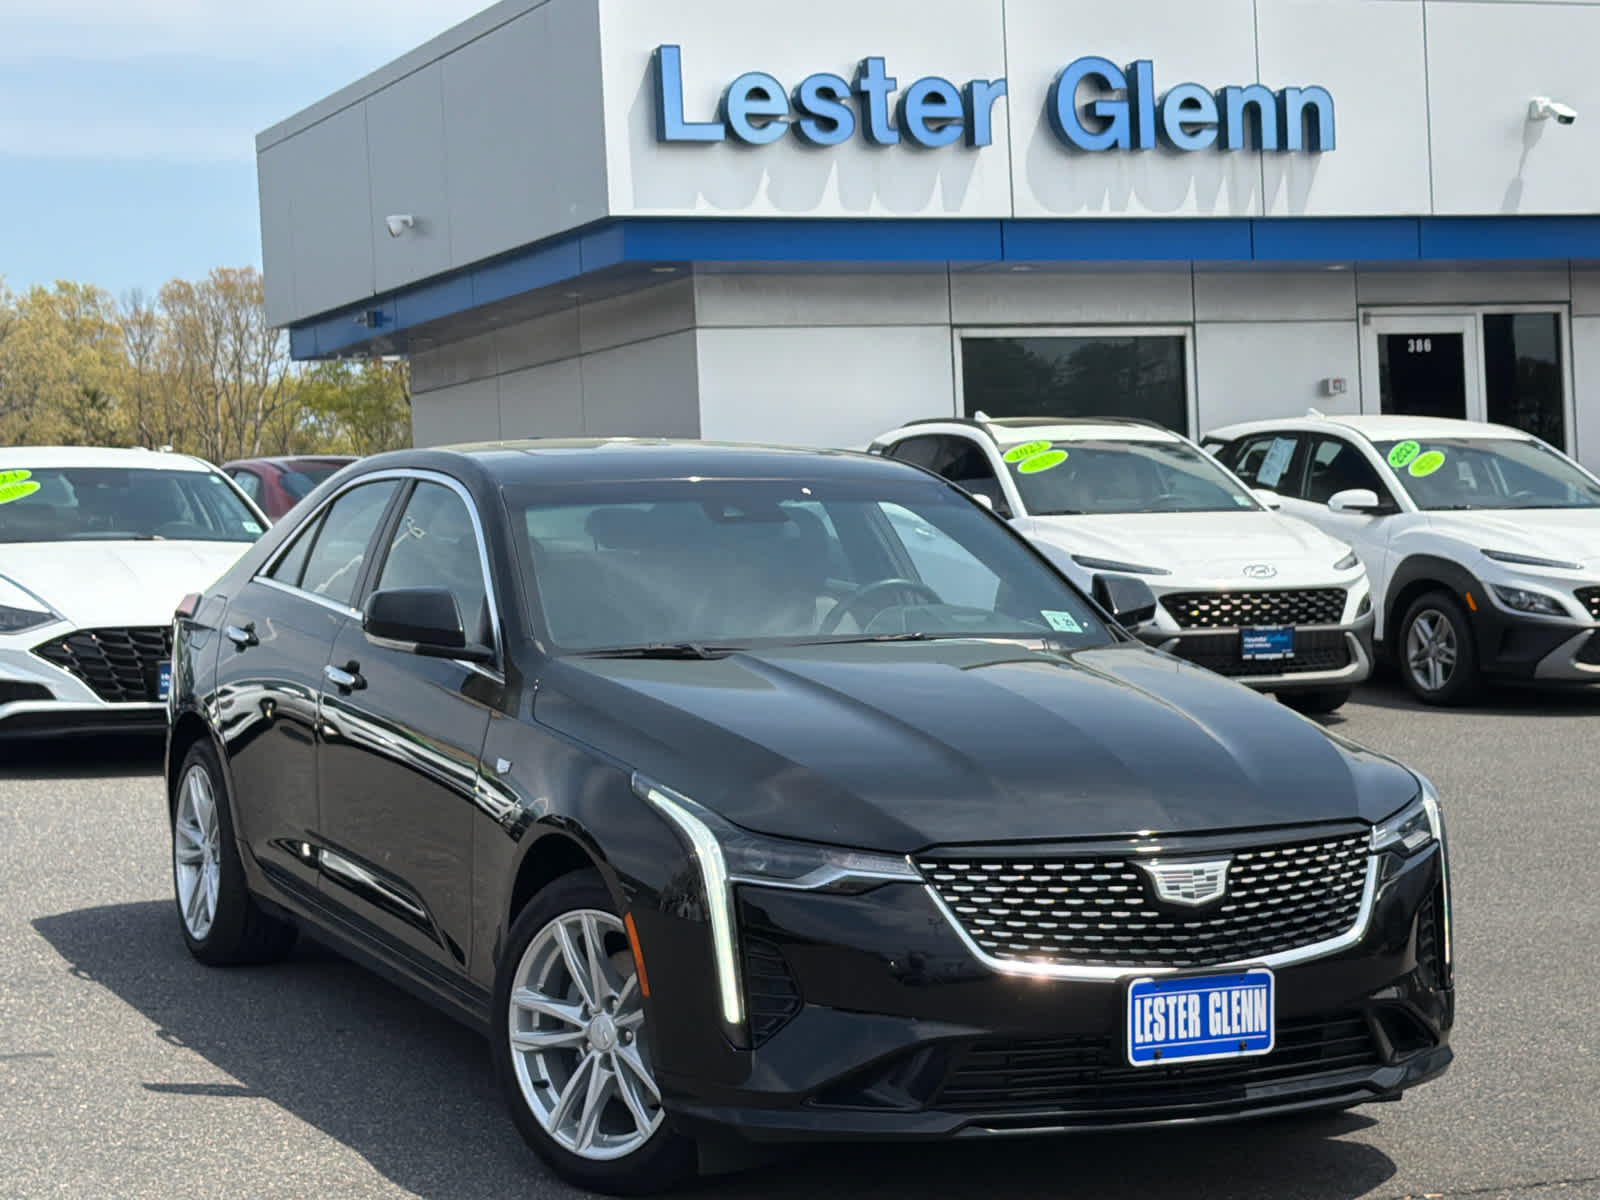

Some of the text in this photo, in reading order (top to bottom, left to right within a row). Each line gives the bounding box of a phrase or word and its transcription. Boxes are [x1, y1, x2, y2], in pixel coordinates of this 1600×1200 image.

[653, 44, 1337, 153] Lester Glenn
[1134, 987, 1267, 1044] LESTER GLENN
